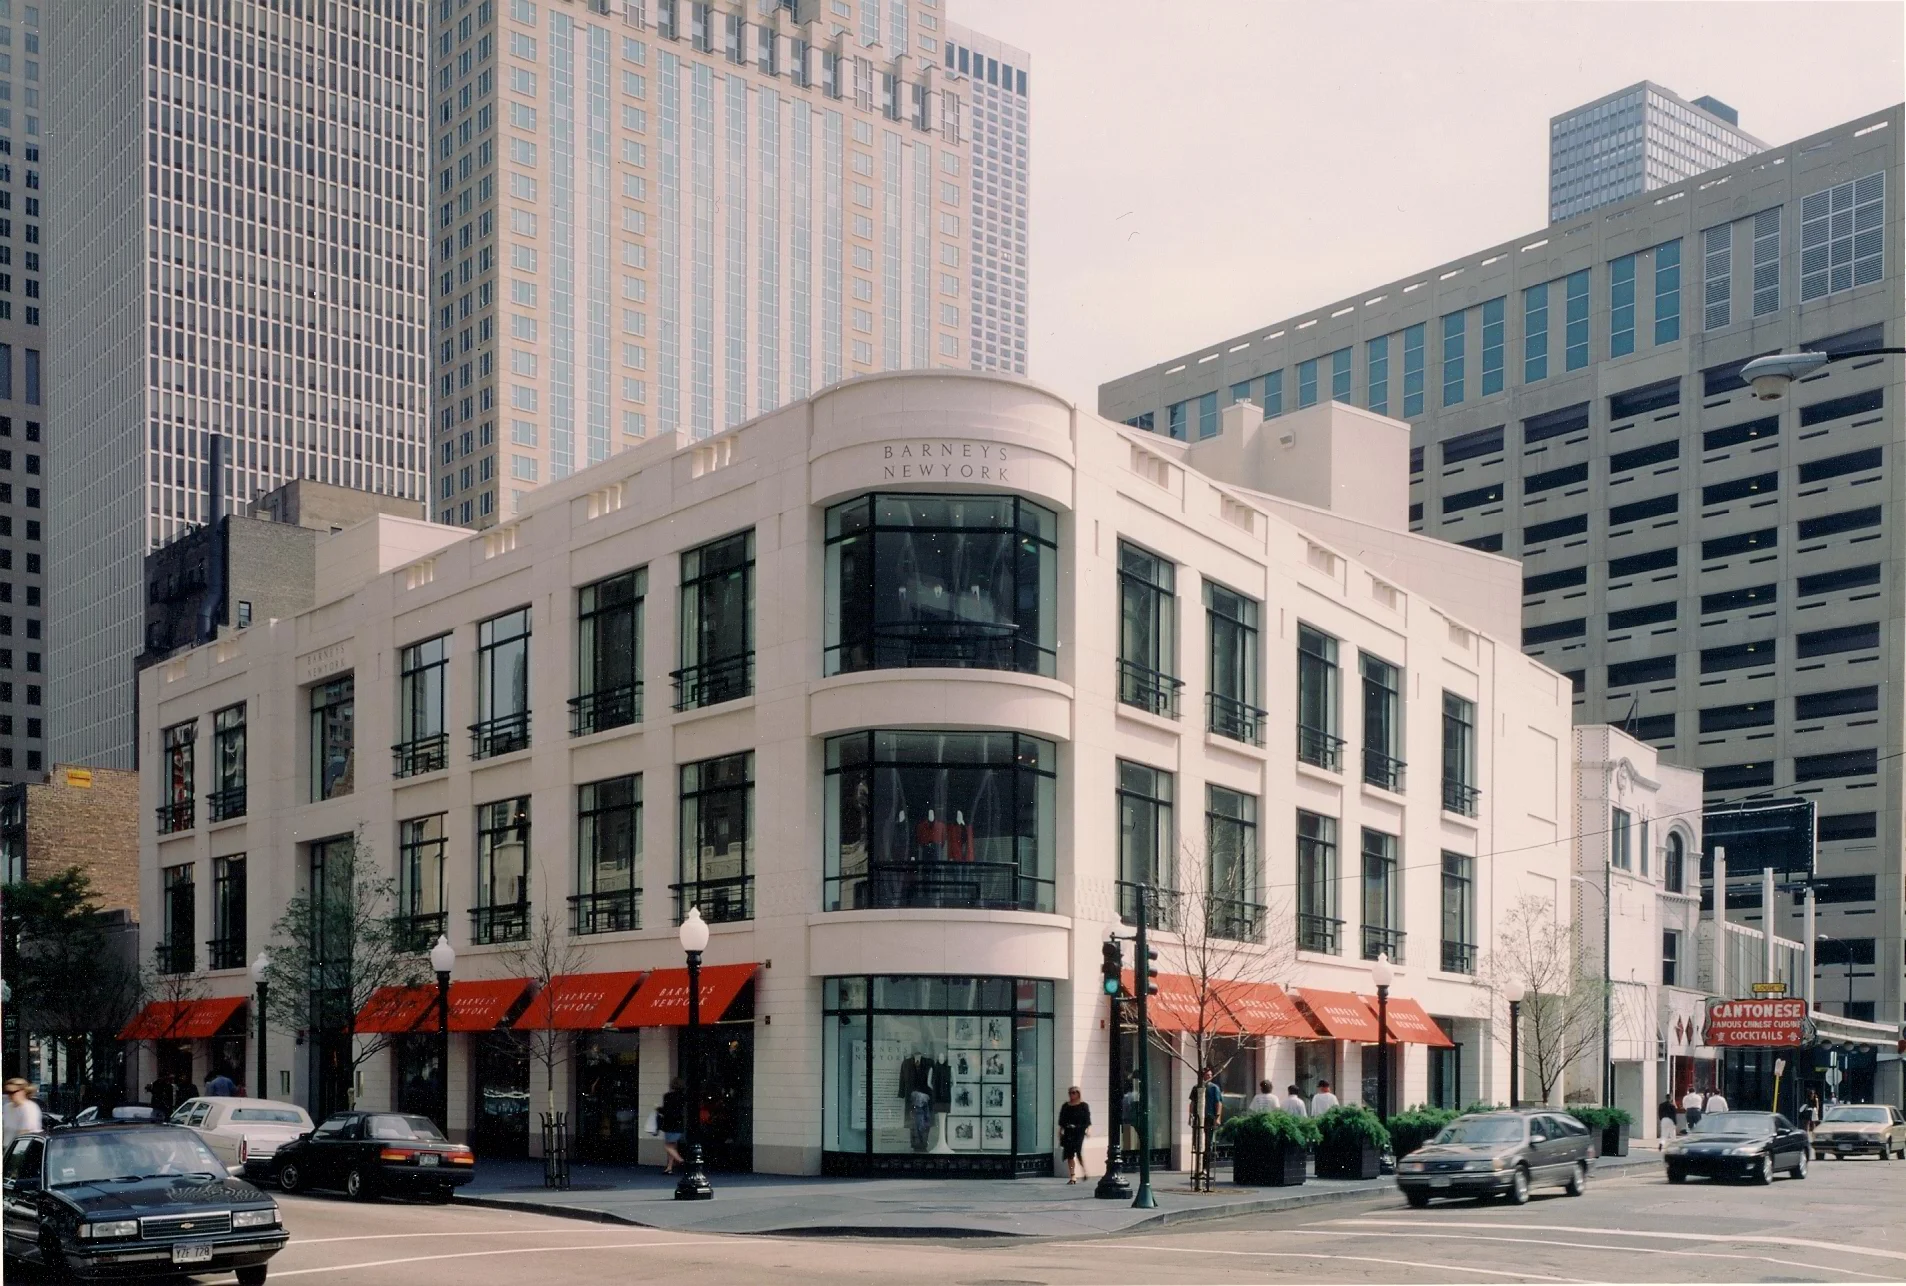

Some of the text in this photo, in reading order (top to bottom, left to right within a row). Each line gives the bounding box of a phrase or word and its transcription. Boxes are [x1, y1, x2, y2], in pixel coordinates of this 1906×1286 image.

[884, 443, 1008, 461] BARNEYS
[659, 985, 715, 996] BARNYS
[1713, 1003, 1801, 1018] CANTONESE
[1712, 1020, 1801, 1029] FAMOUS CHINESE CUISINE
[1730, 1031, 1783, 1041] COCKTAILS
